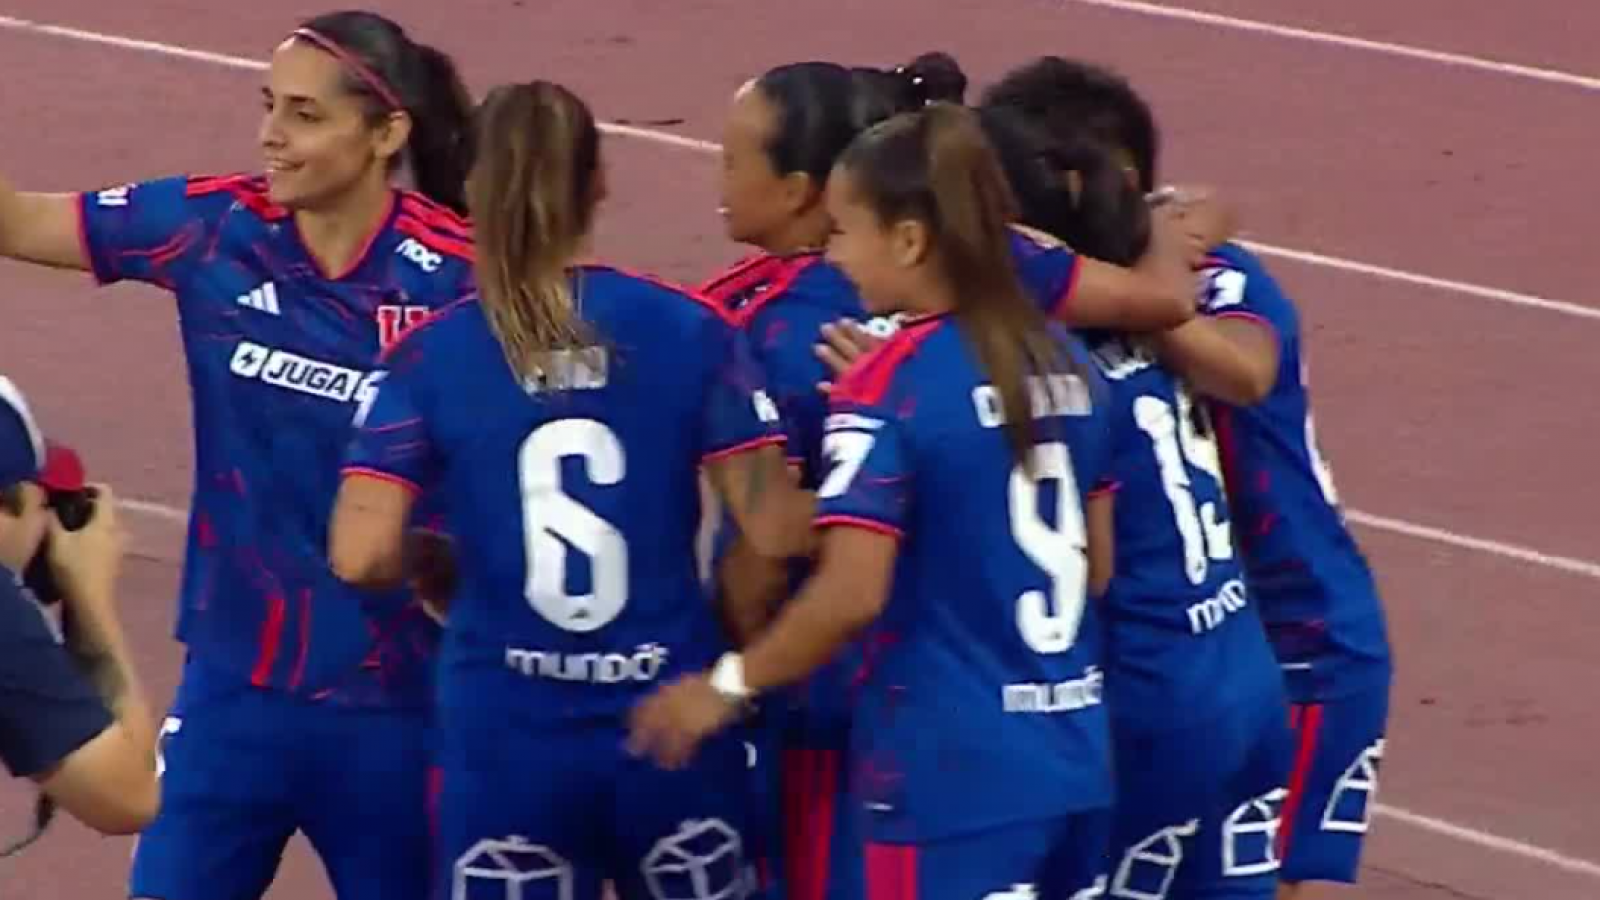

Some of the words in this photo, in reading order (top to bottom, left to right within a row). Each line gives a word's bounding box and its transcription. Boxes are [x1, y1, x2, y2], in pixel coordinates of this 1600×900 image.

[267, 360, 350, 395] JUGA
[517, 418, 628, 631] 6
[1008, 441, 1088, 654] 9
